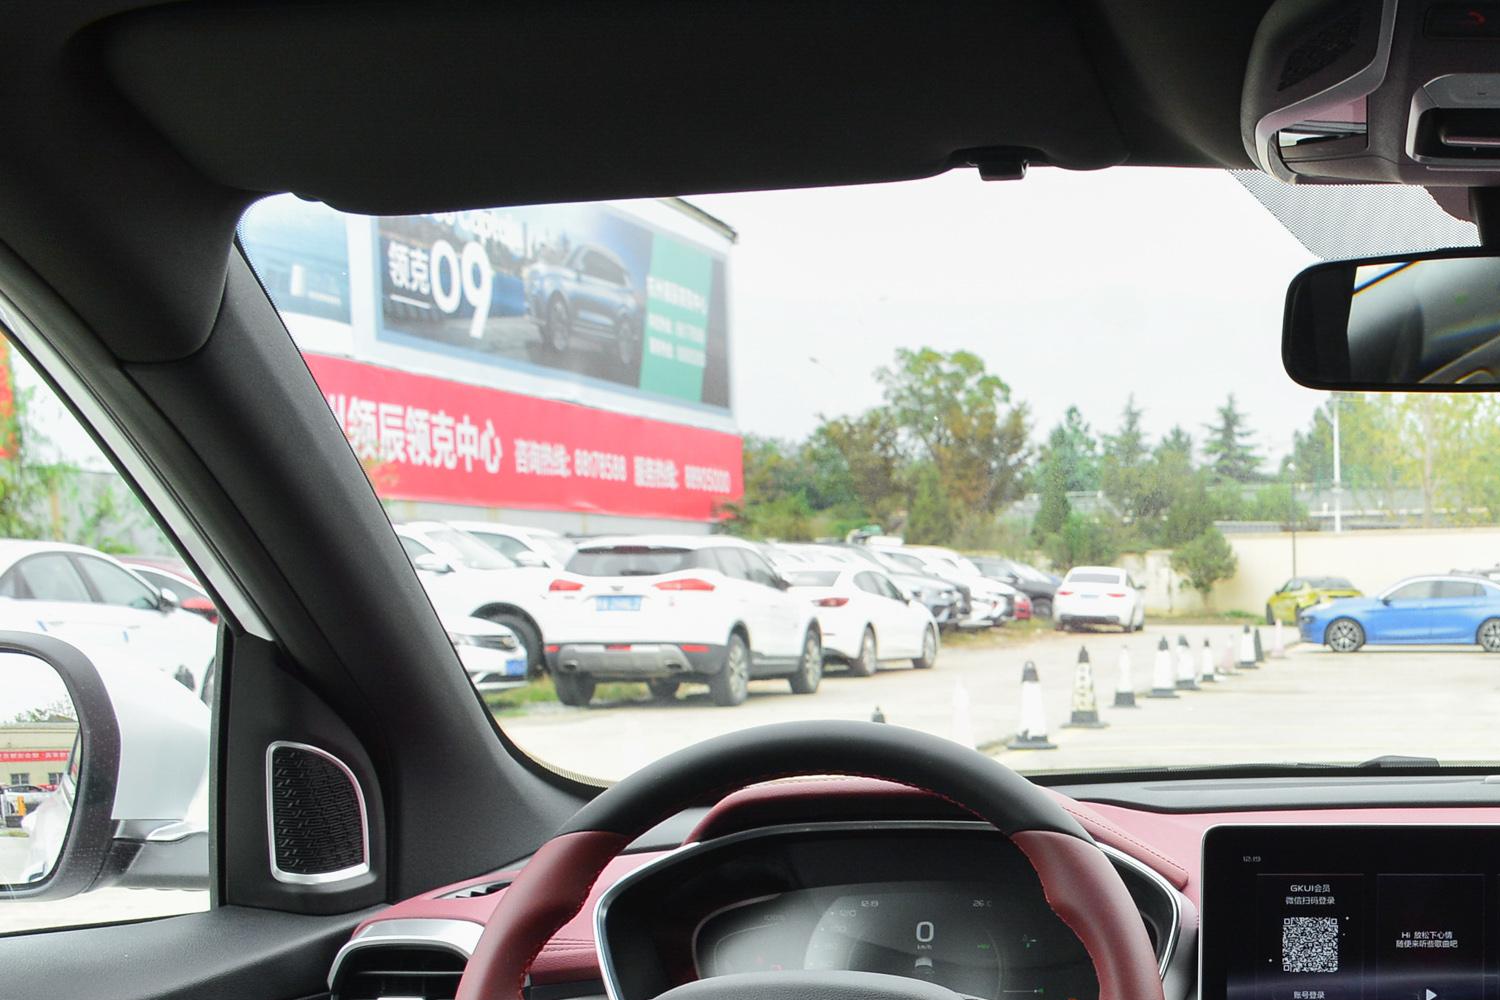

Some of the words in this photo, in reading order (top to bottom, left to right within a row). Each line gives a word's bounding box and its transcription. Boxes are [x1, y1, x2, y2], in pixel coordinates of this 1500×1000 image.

[1290, 884, 1331, 893] GKUI会员
[1285, 896, 1336, 905] 微信扫码登录
[916, 921, 934, 943] 0
[1401, 931, 1411, 939] Hi
[1414, 931, 1453, 939] 放松下心情
[1395, 940, 1458, 948] 随便来听些歌曲吧
[1293, 991, 1326, 1000] 账号登录
